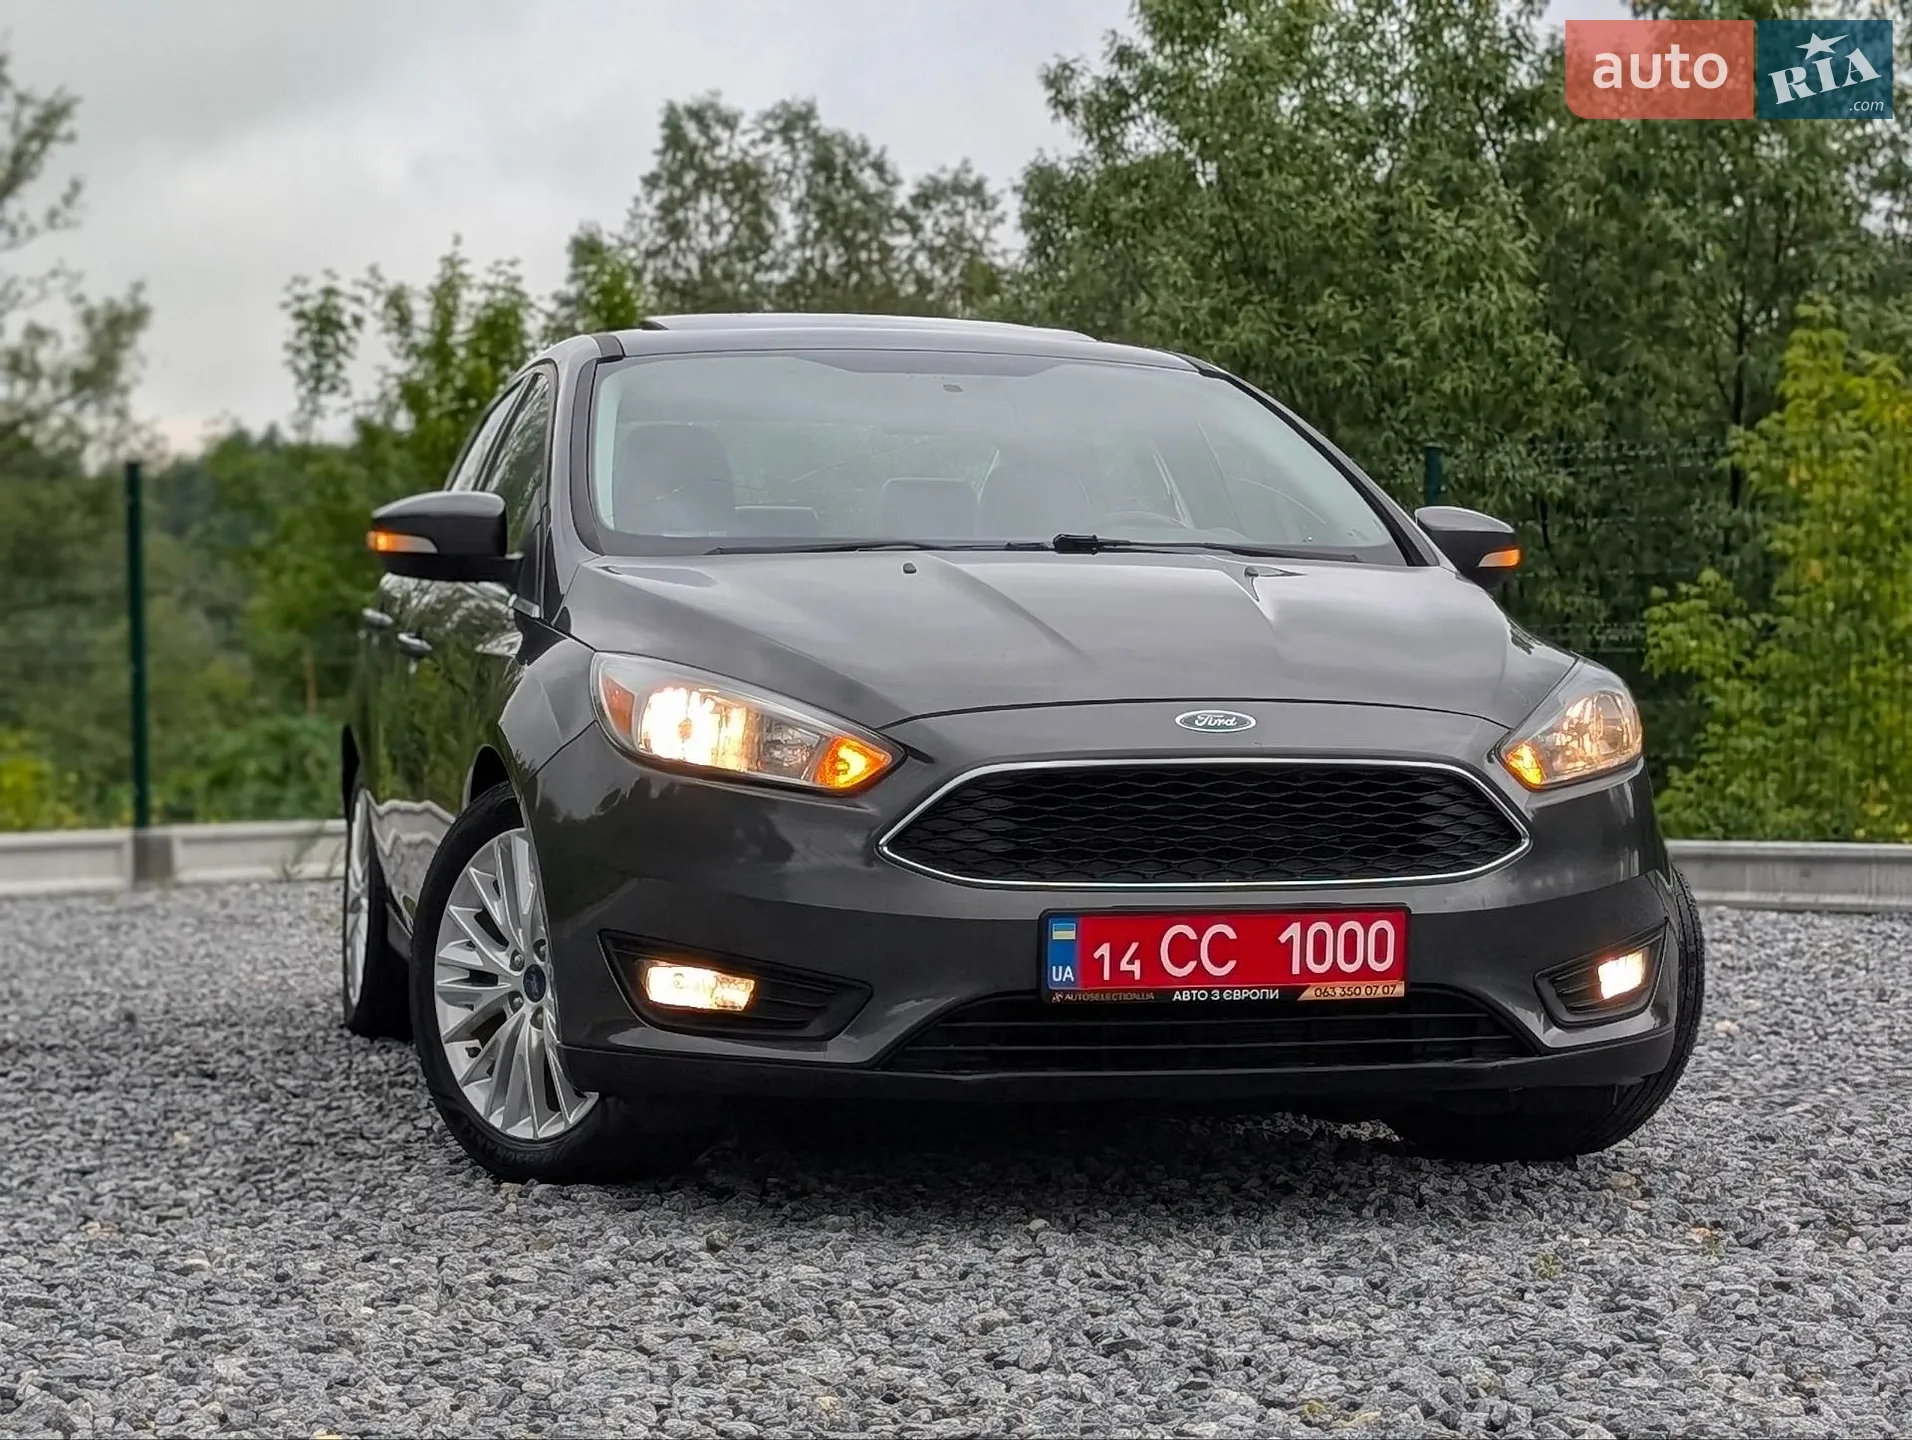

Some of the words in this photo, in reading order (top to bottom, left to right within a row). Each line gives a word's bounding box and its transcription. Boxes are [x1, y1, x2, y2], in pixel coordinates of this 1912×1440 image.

[1194, 714, 1237, 726] Ford
[1093, 942, 1141, 981] 14
[1160, 924, 1237, 977] CC
[1278, 920, 1396, 975] 1000
[1052, 966, 1074, 982] UA
[1172, 990, 1208, 1001] АВТО
[1222, 989, 1279, 1000] ЄВРОПИ
[1314, 987, 1337, 997] 063
[1339, 986, 1362, 997] 350
[1364, 986, 1378, 996] 07
[1381, 984, 1397, 996] 07
